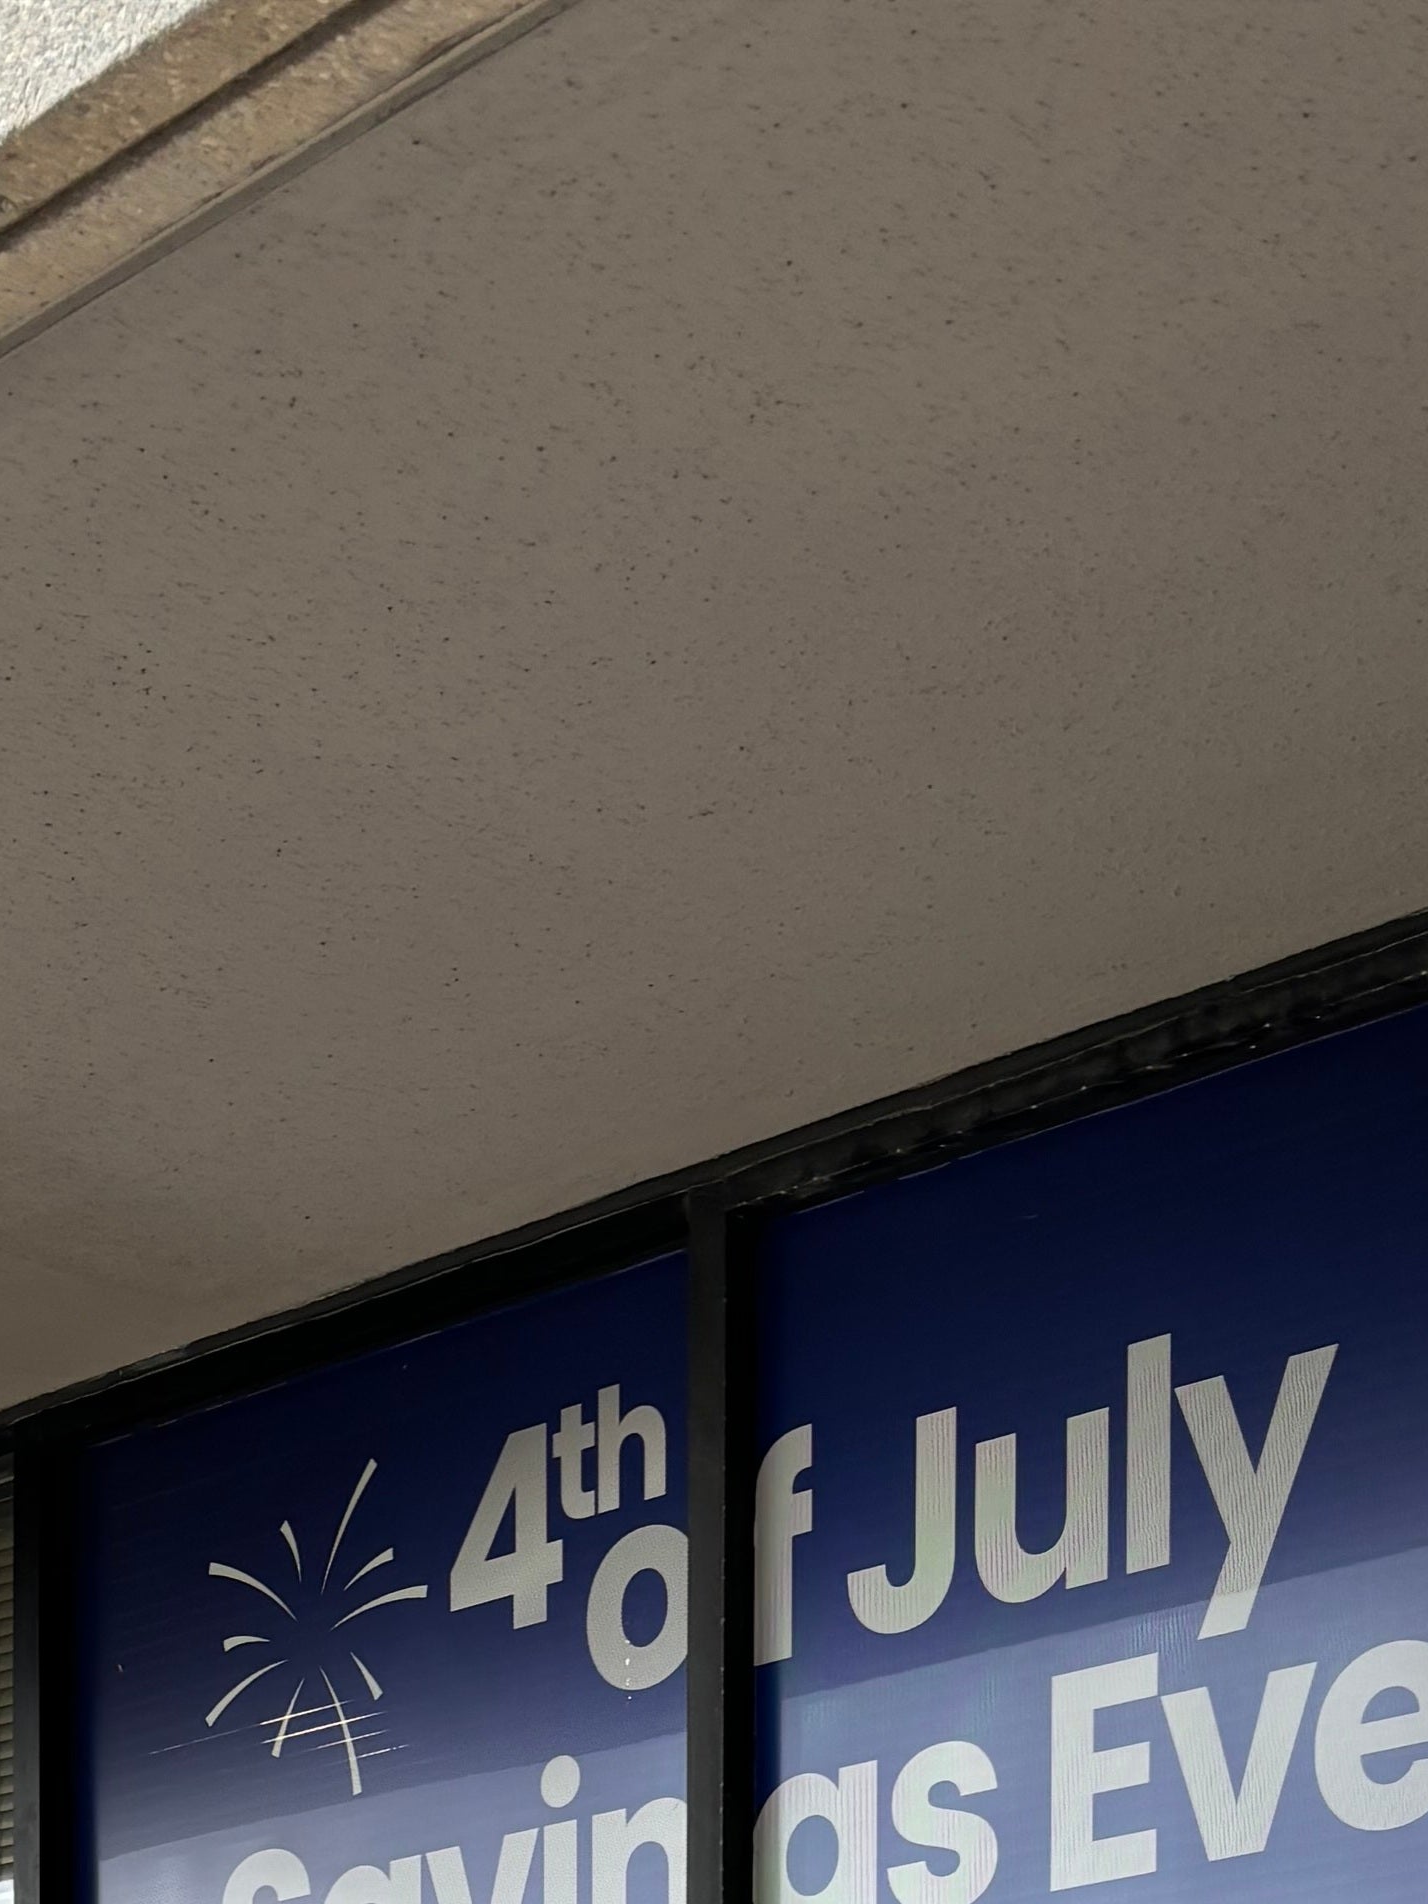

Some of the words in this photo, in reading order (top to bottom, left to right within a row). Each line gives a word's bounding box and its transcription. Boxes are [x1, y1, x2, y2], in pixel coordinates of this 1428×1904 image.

[449, 1383, 667, 1630] 4th
[586, 1423, 813, 1691] of
[847, 1333, 1339, 1640] July
